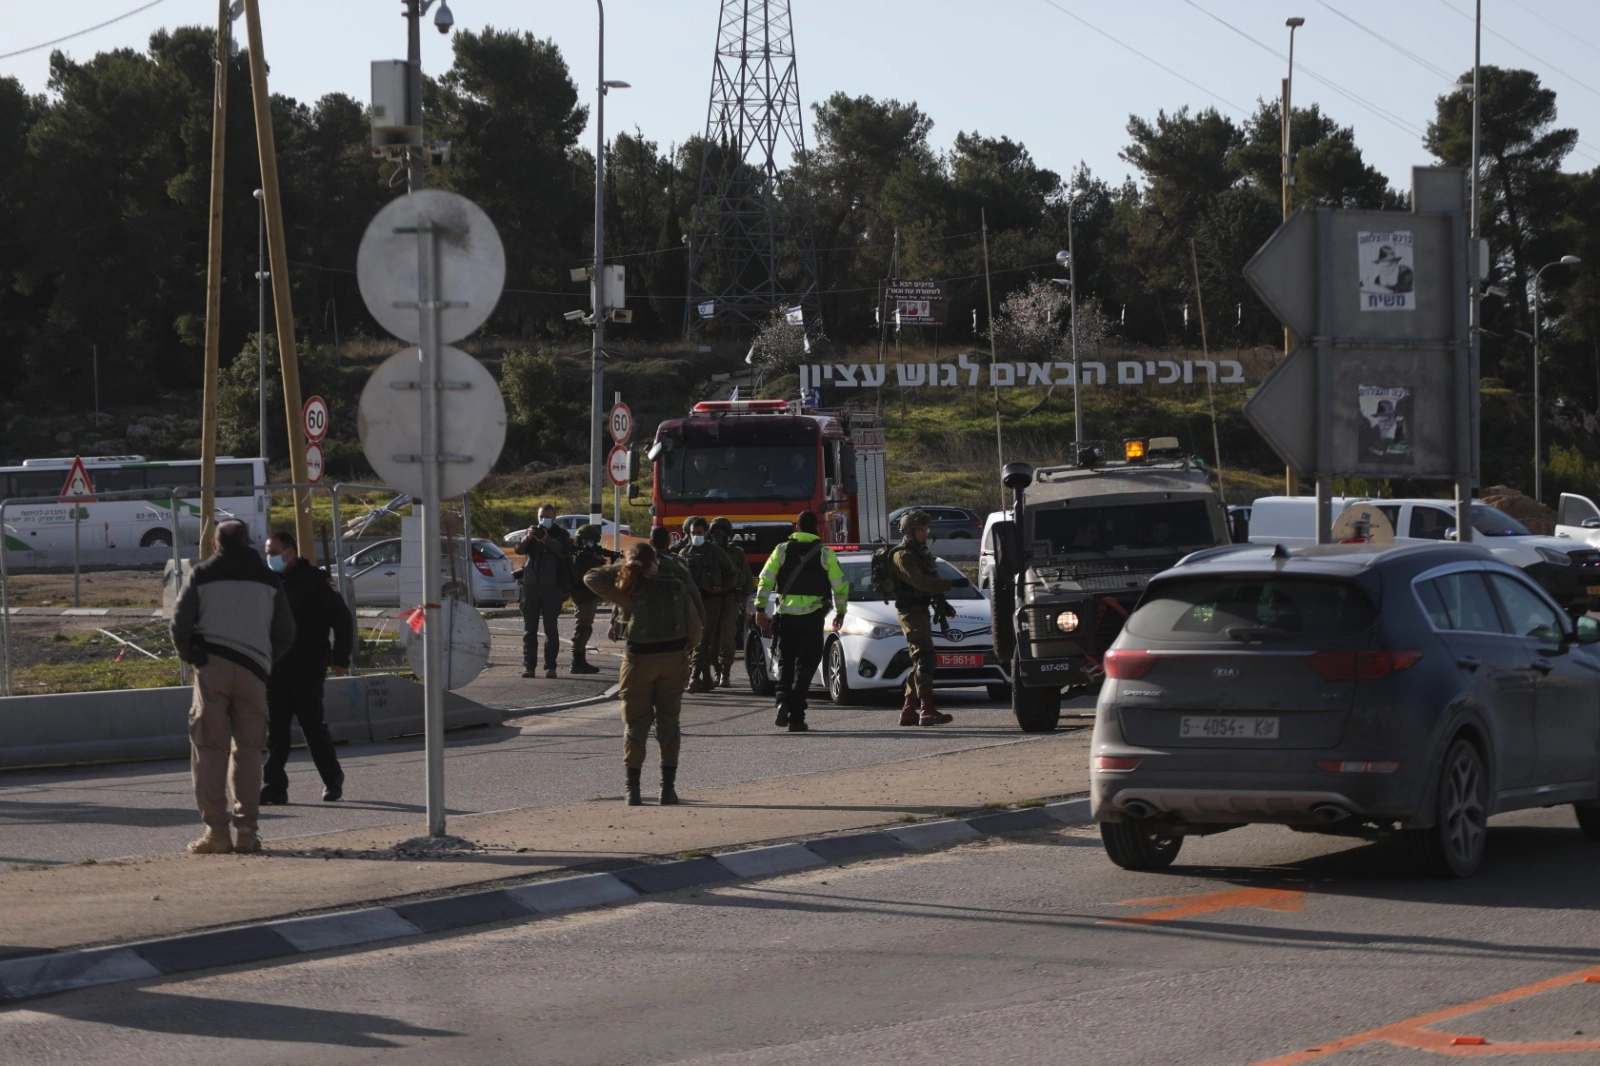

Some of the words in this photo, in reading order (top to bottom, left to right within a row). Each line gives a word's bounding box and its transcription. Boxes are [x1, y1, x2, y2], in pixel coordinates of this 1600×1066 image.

[1368, 294, 1405, 307] משיח
[799, 363, 886, 396] עציון
[897, 354, 980, 387] לגוש
[989, 361, 1106, 387] הבאים
[1117, 359, 1246, 385] ברוכים
[308, 410, 324, 429] 60
[613, 413, 628, 432] 60
[727, 533, 756, 541] AN
[1216, 668, 1235, 676] KIA
